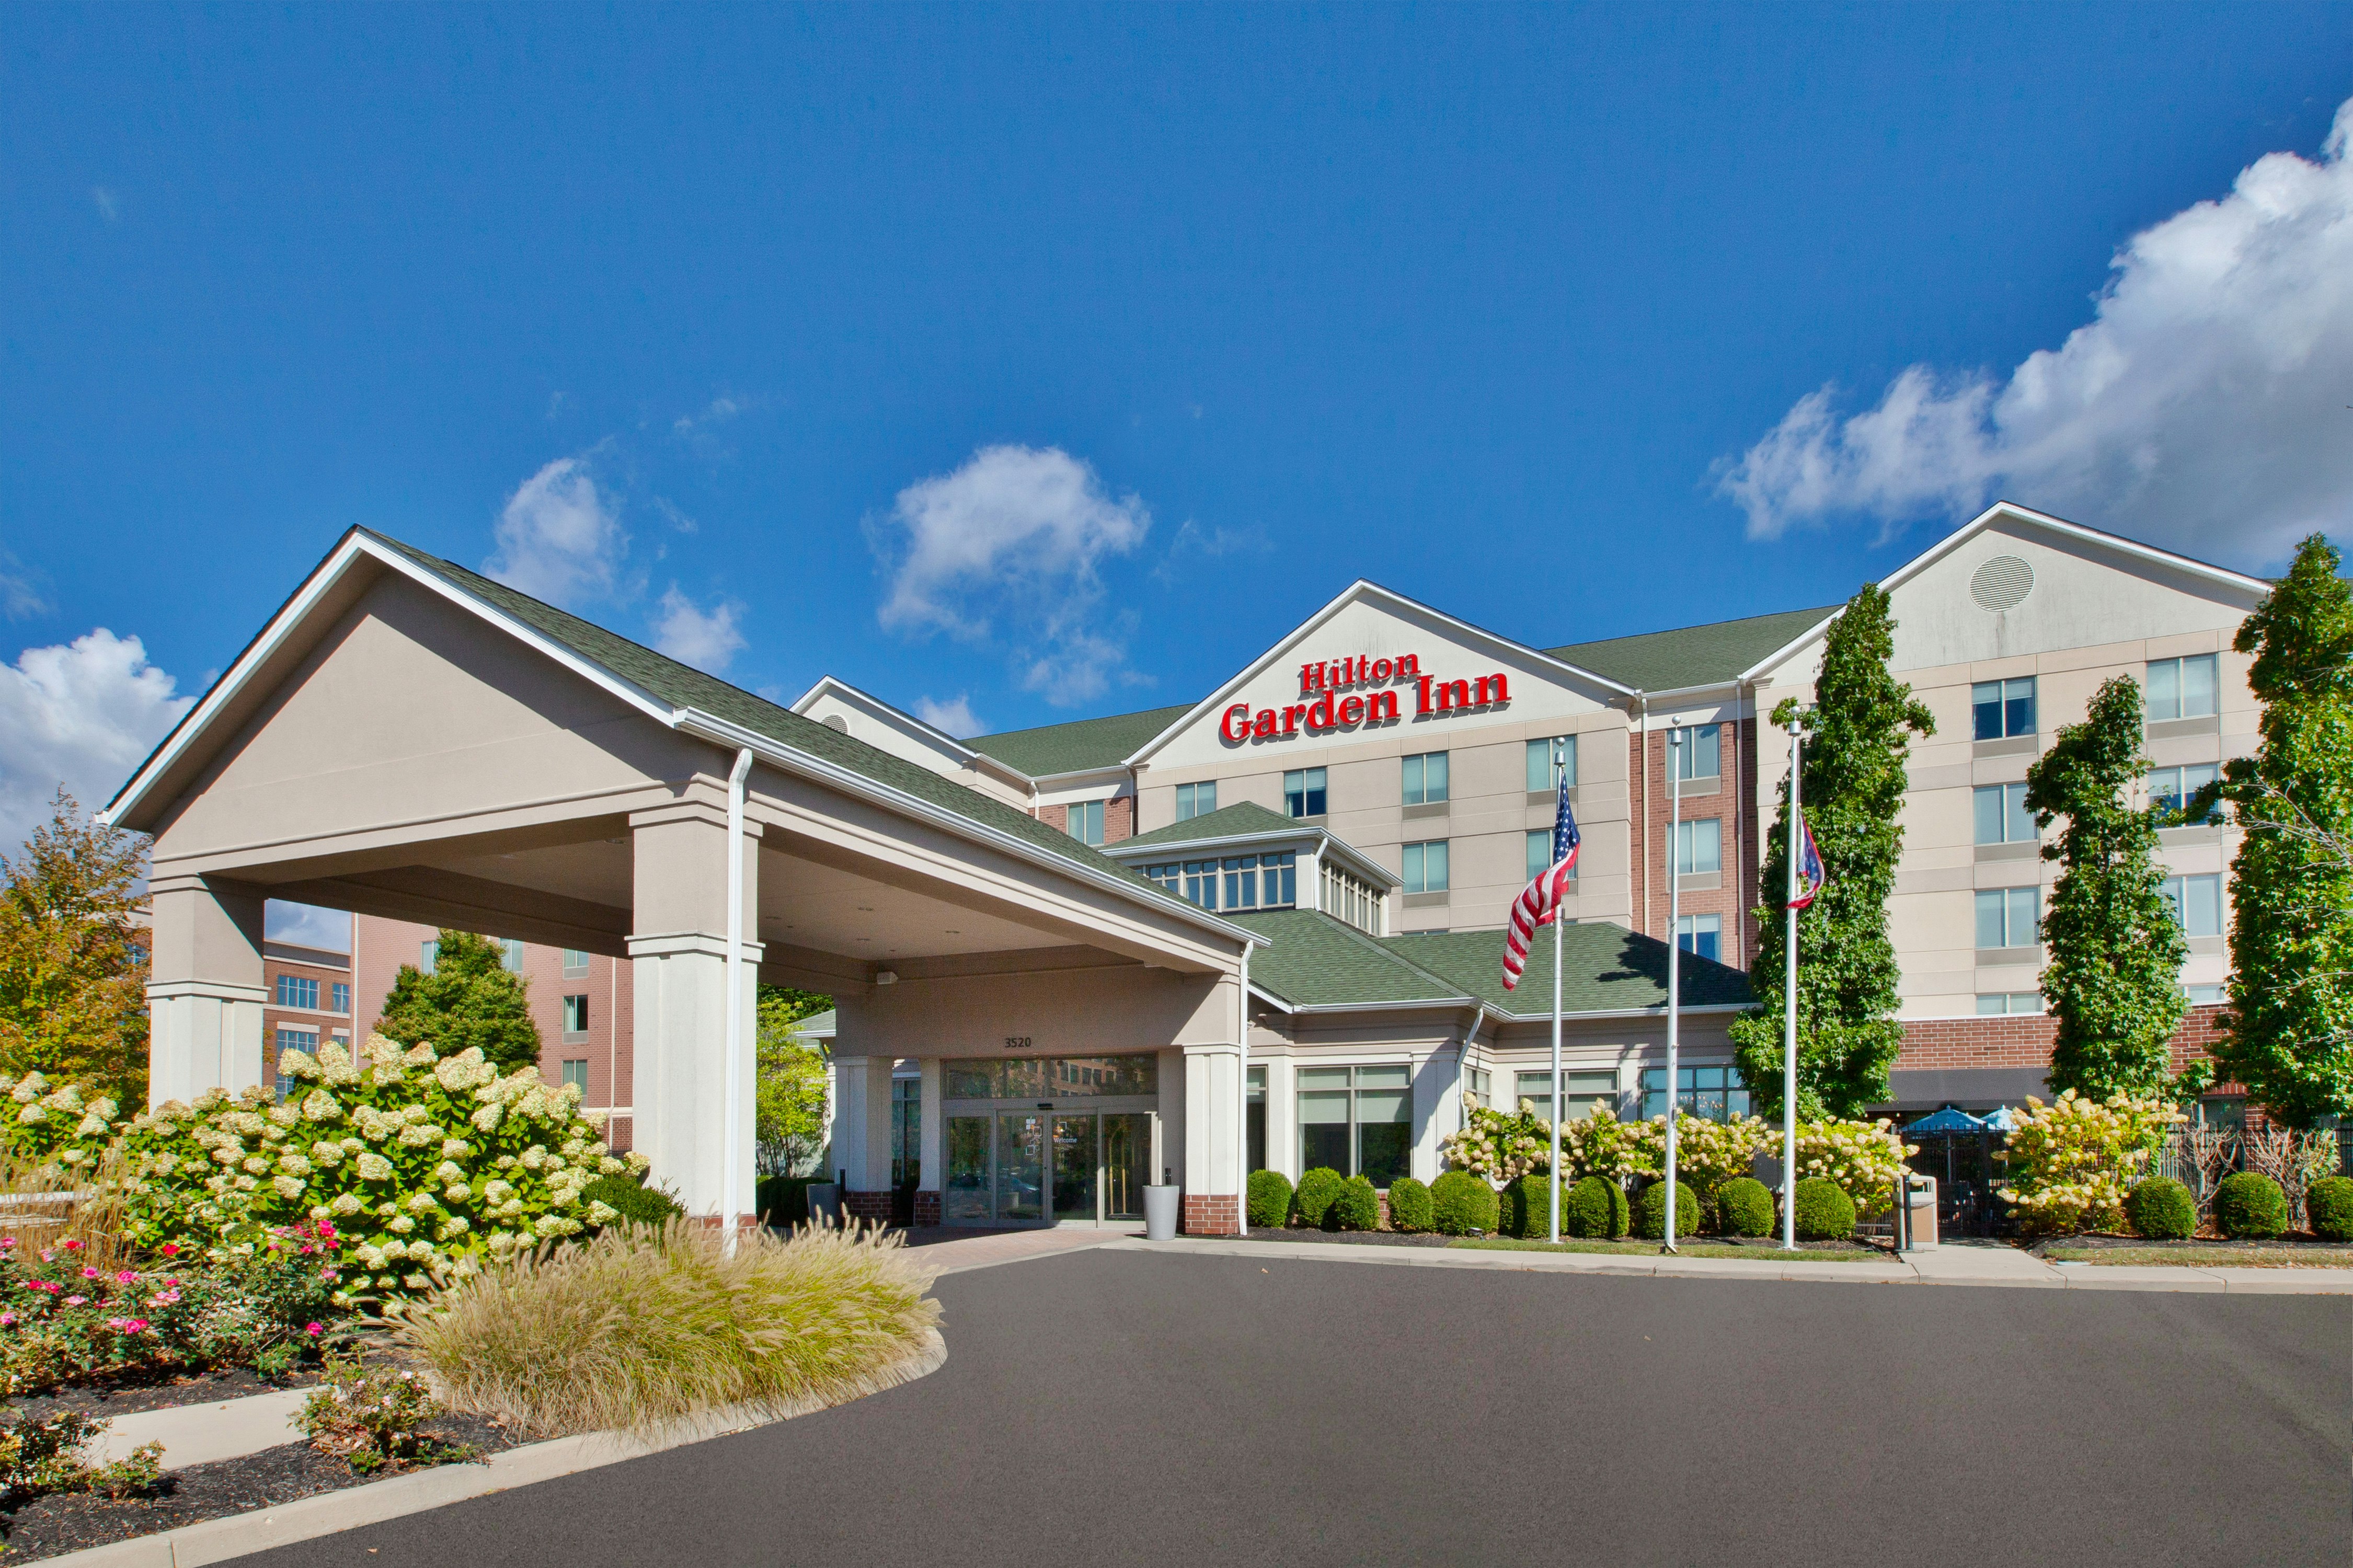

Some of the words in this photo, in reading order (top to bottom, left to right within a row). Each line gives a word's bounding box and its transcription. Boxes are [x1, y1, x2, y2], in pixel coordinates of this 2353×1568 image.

[1301, 653, 1421, 692] Hilton
[1221, 689, 1402, 741] Garden
[1416, 673, 1512, 714] Inn
[1004, 1037, 1031, 1048] 3520
